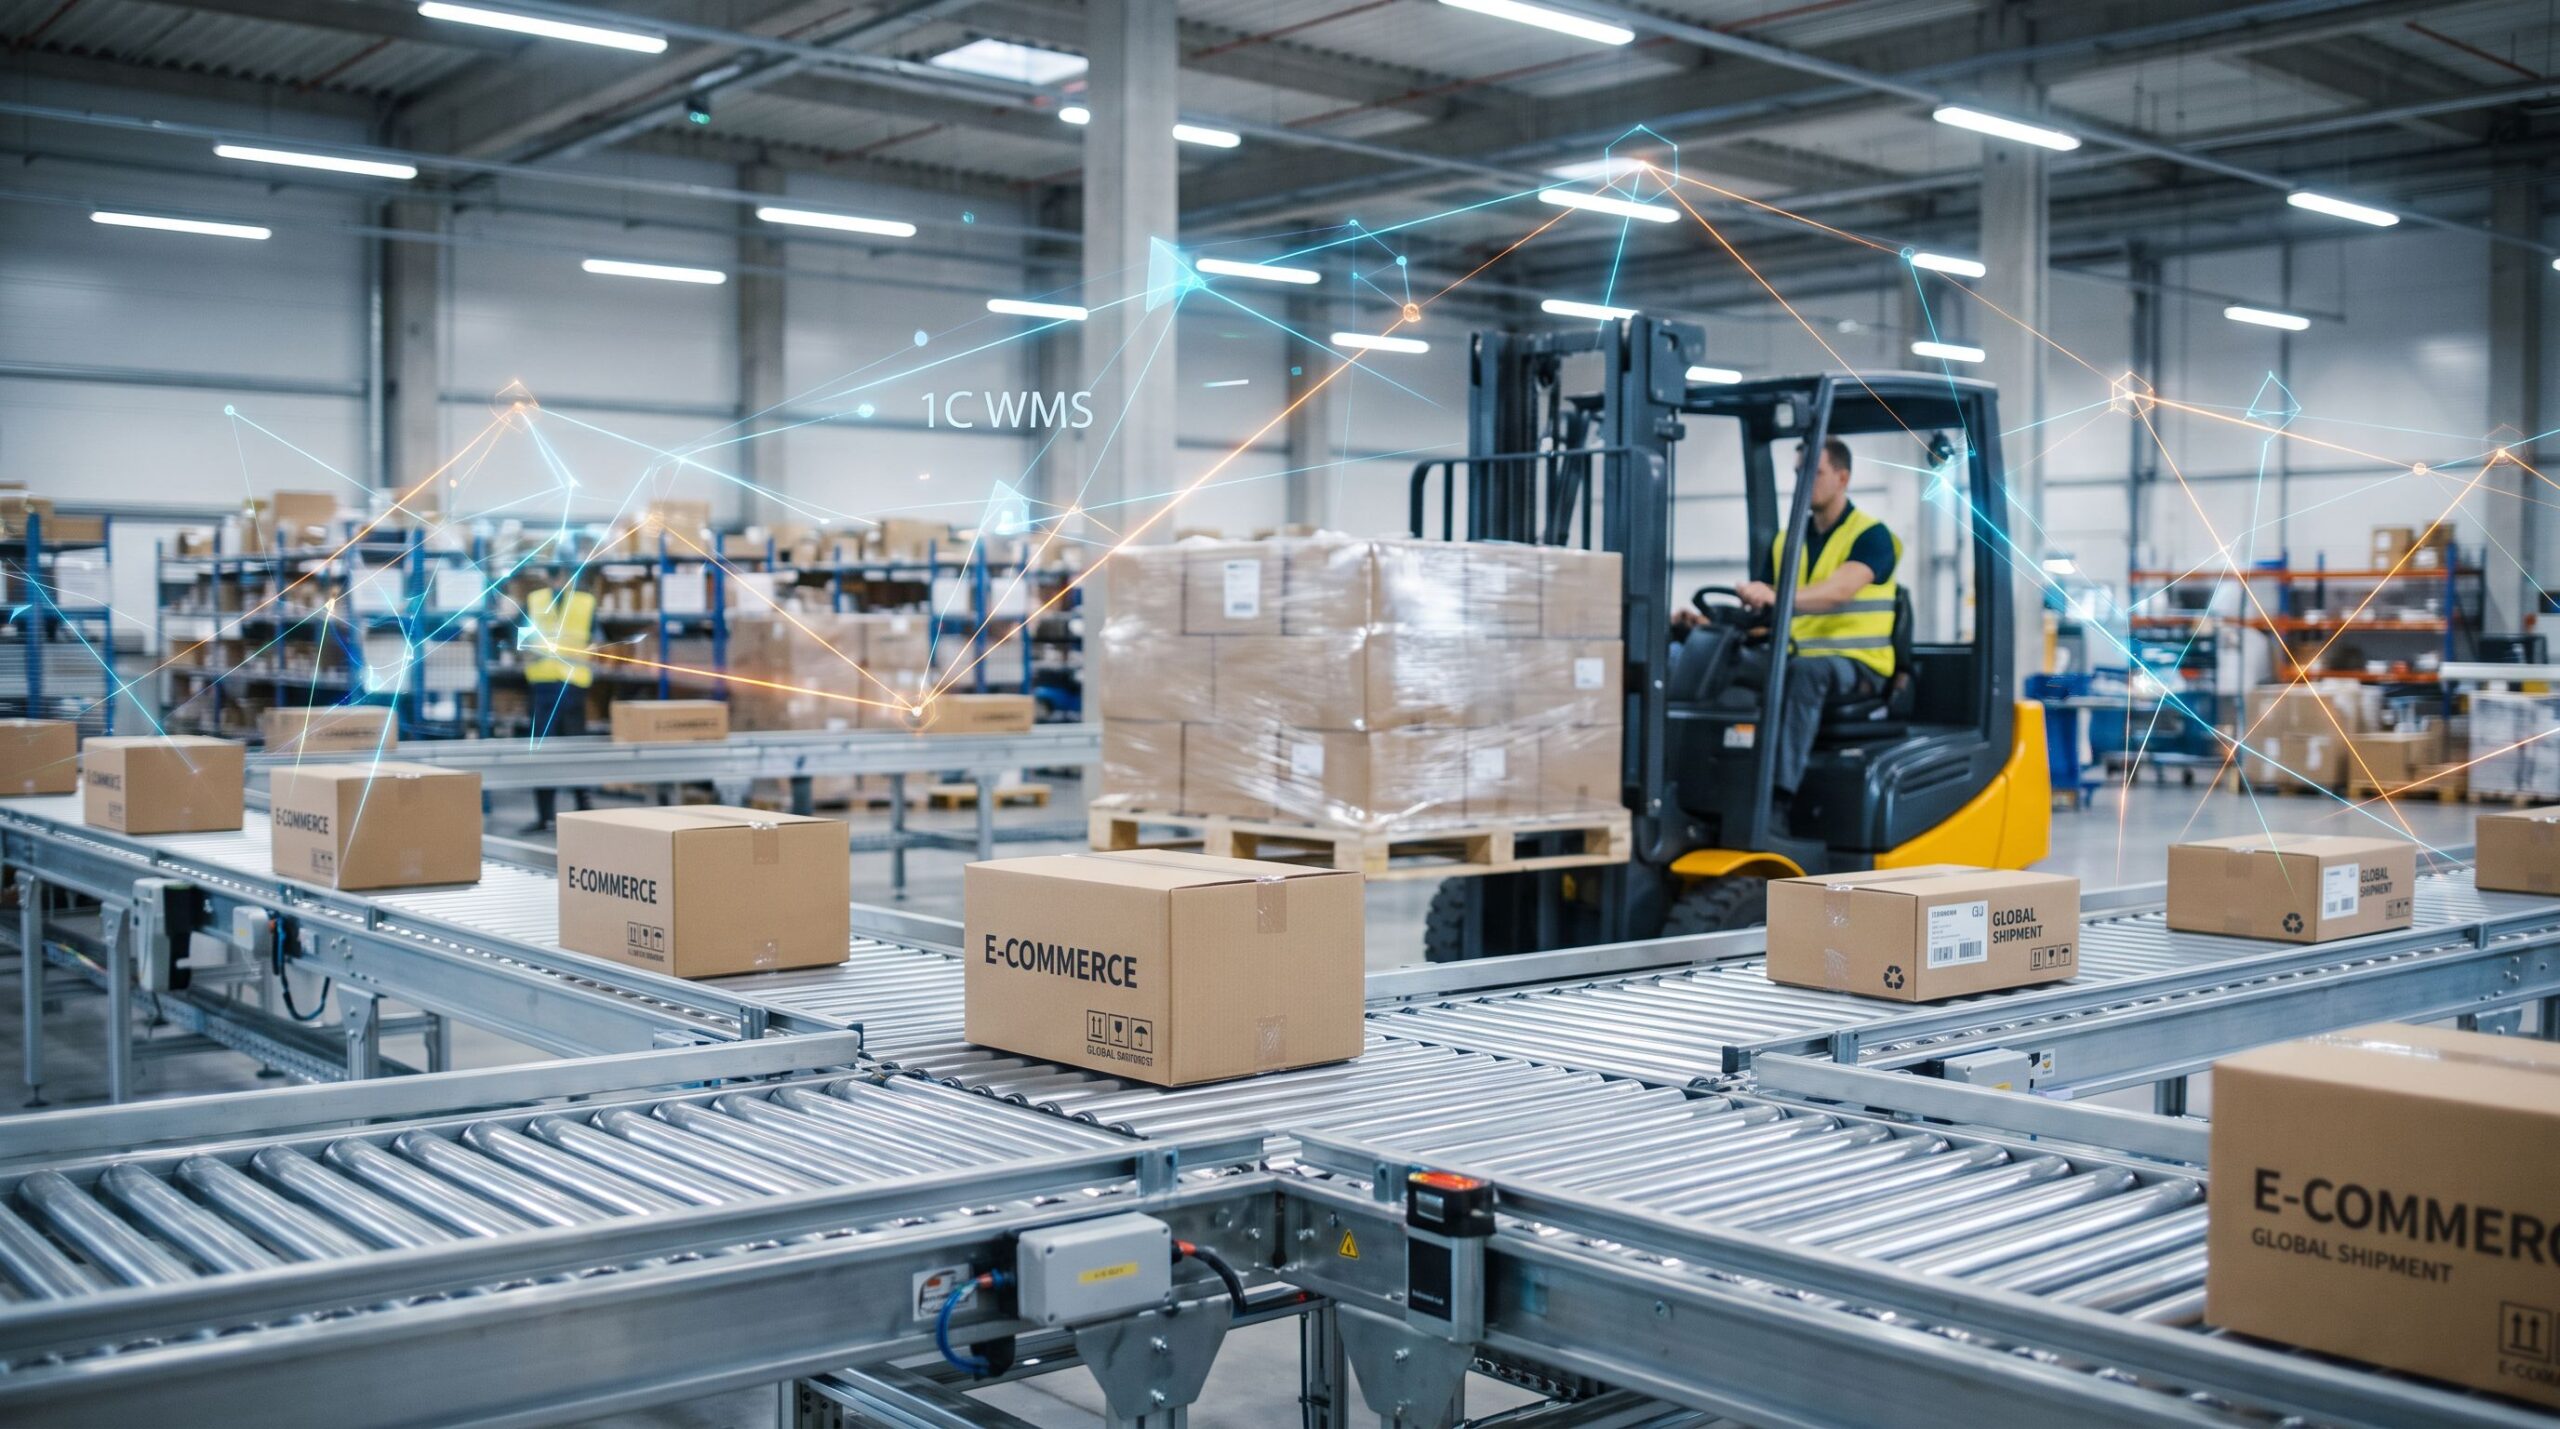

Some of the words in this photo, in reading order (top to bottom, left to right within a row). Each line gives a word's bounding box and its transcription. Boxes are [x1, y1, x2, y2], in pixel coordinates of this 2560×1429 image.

[2360, 867, 2388, 883] GLOBAL
[568, 866, 657, 905] E-COMMERCE
[1992, 907, 2036, 927] GLOBAL
[1992, 925, 2043, 944] SHIPMENT
[985, 934, 1138, 988] E-COMMERCE
[1087, 1045, 1116, 1060] GLOBAL
[2252, 1227, 2333, 1260] GLOBAL
[2337, 1243, 2454, 1283] SHIPMENT
